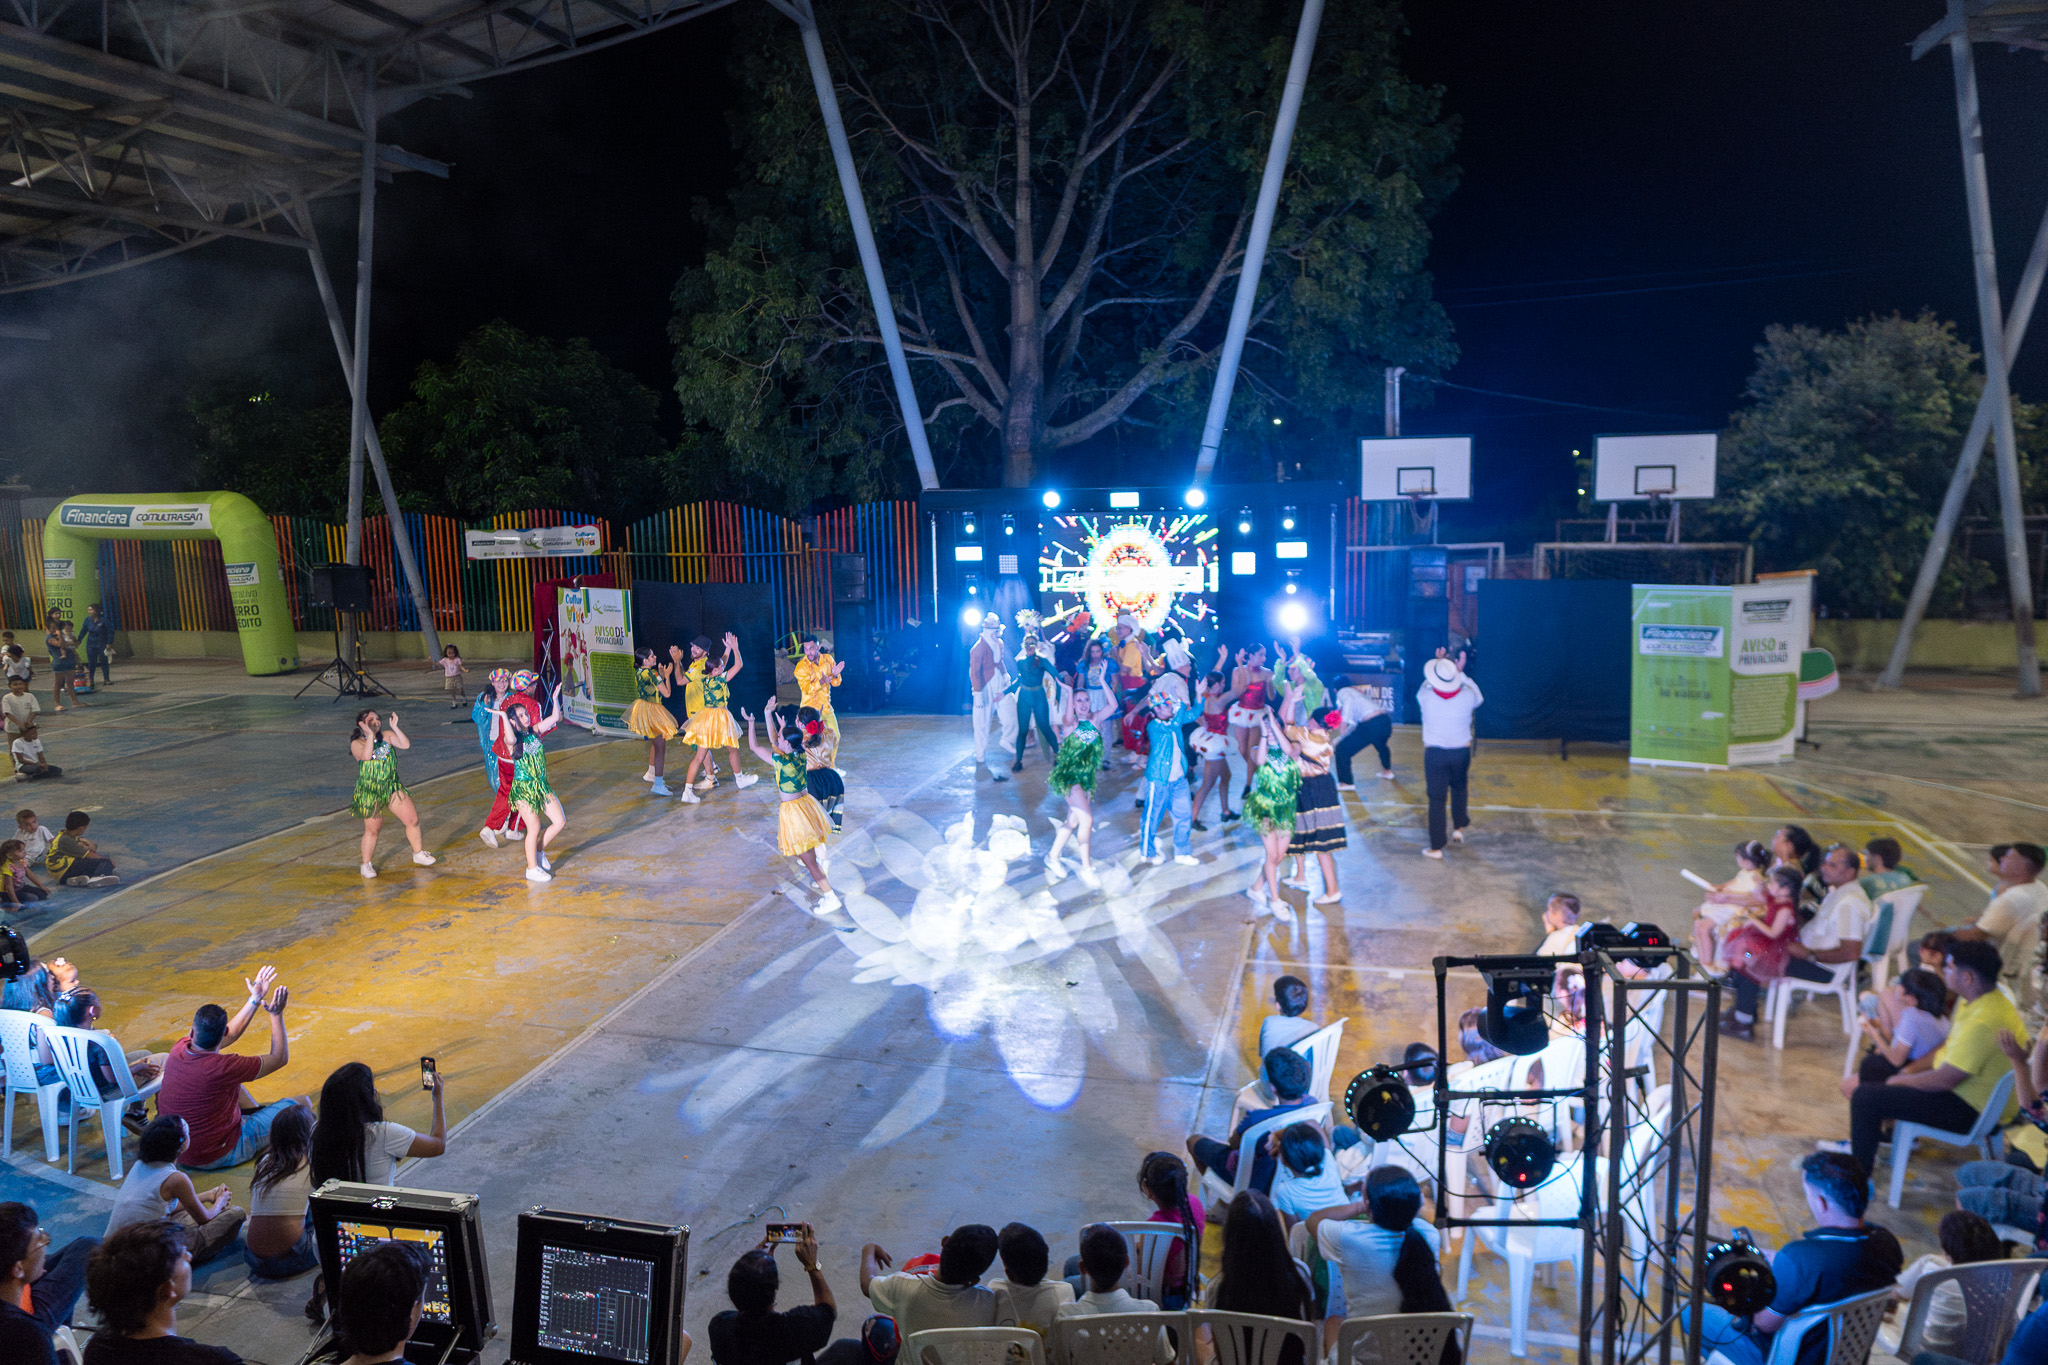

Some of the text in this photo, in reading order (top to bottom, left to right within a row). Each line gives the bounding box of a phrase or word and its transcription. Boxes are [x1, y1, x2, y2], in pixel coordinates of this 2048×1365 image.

[66, 508, 203, 525] Financiera COMULTRASAN
[594, 625, 625, 638] AVISO DE
[1643, 627, 1714, 640] Financiera
[595, 636, 624, 646] PRIVACIDAD
[1741, 637, 1788, 653] AVISO DE
[1738, 652, 1789, 665] PRIVACIDAD
